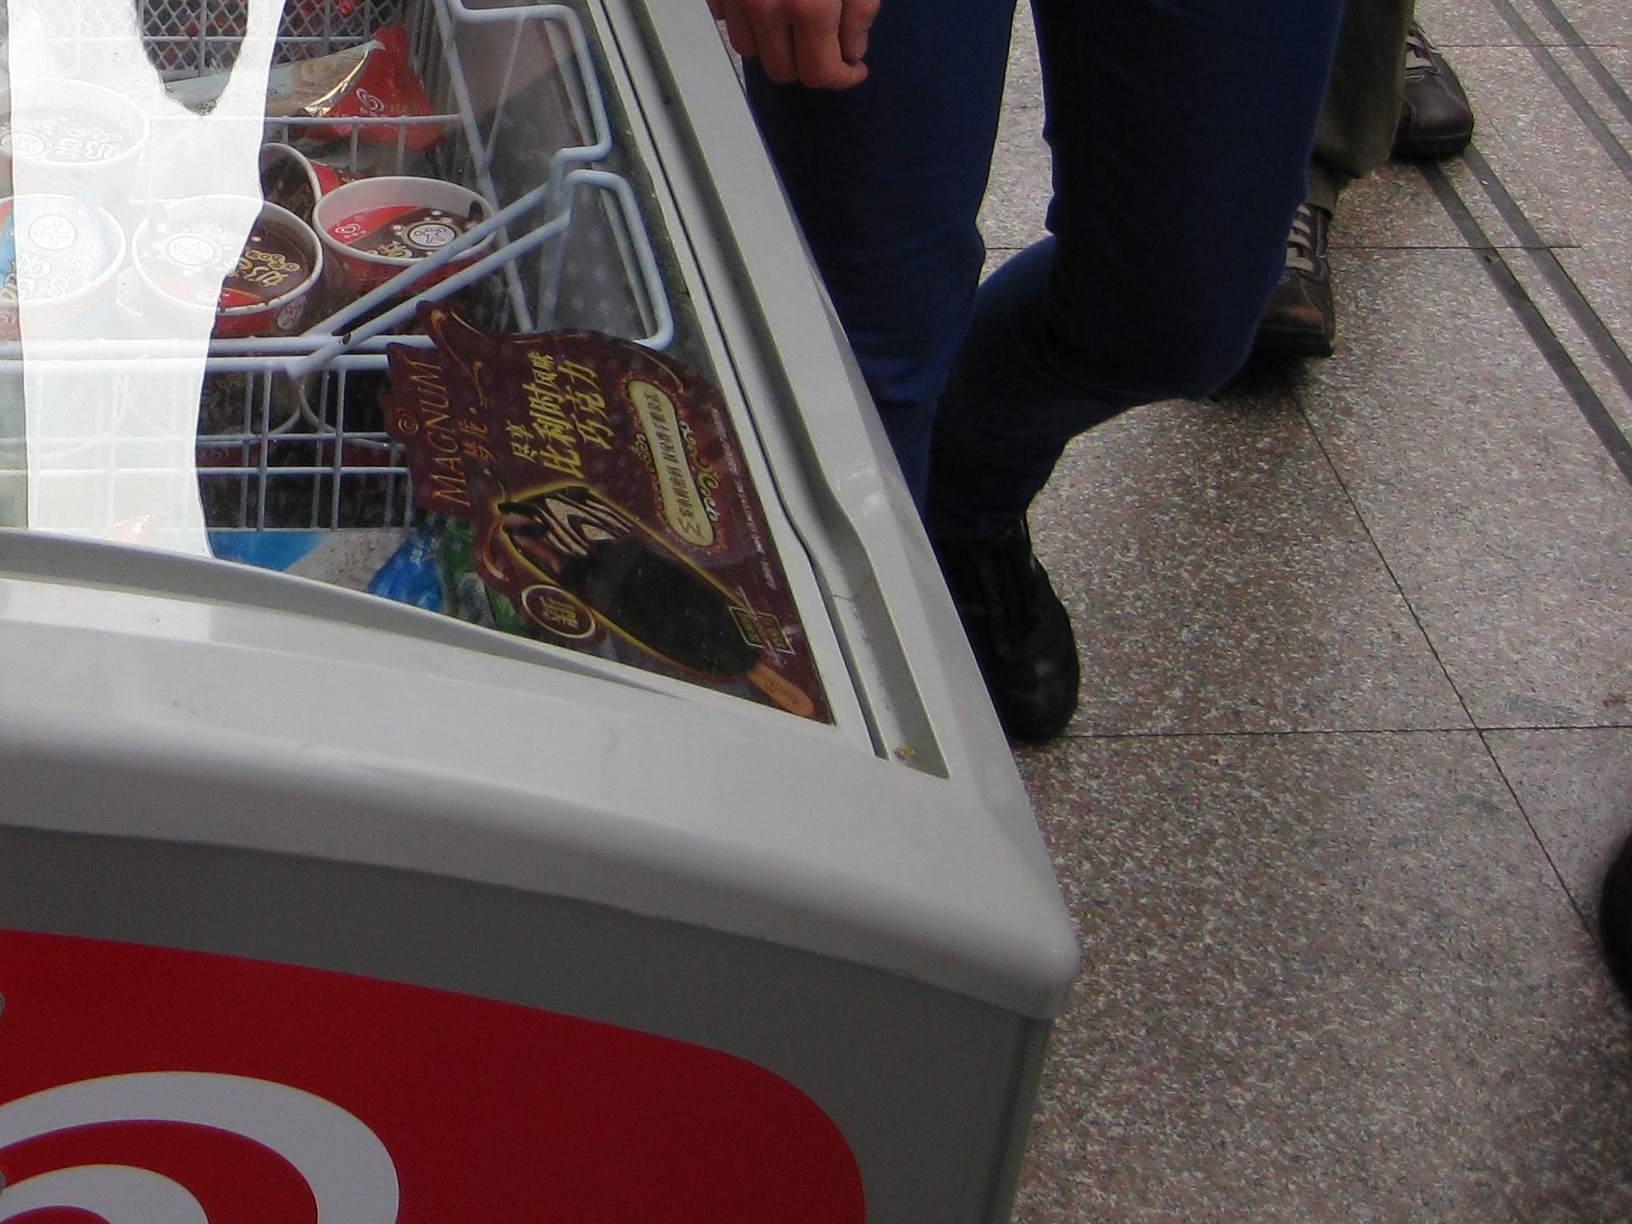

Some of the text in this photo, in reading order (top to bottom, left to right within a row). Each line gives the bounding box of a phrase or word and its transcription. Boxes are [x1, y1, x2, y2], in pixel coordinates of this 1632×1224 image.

[409, 354, 471, 508] MAGNUM
[557, 359, 616, 450] 巧克力
